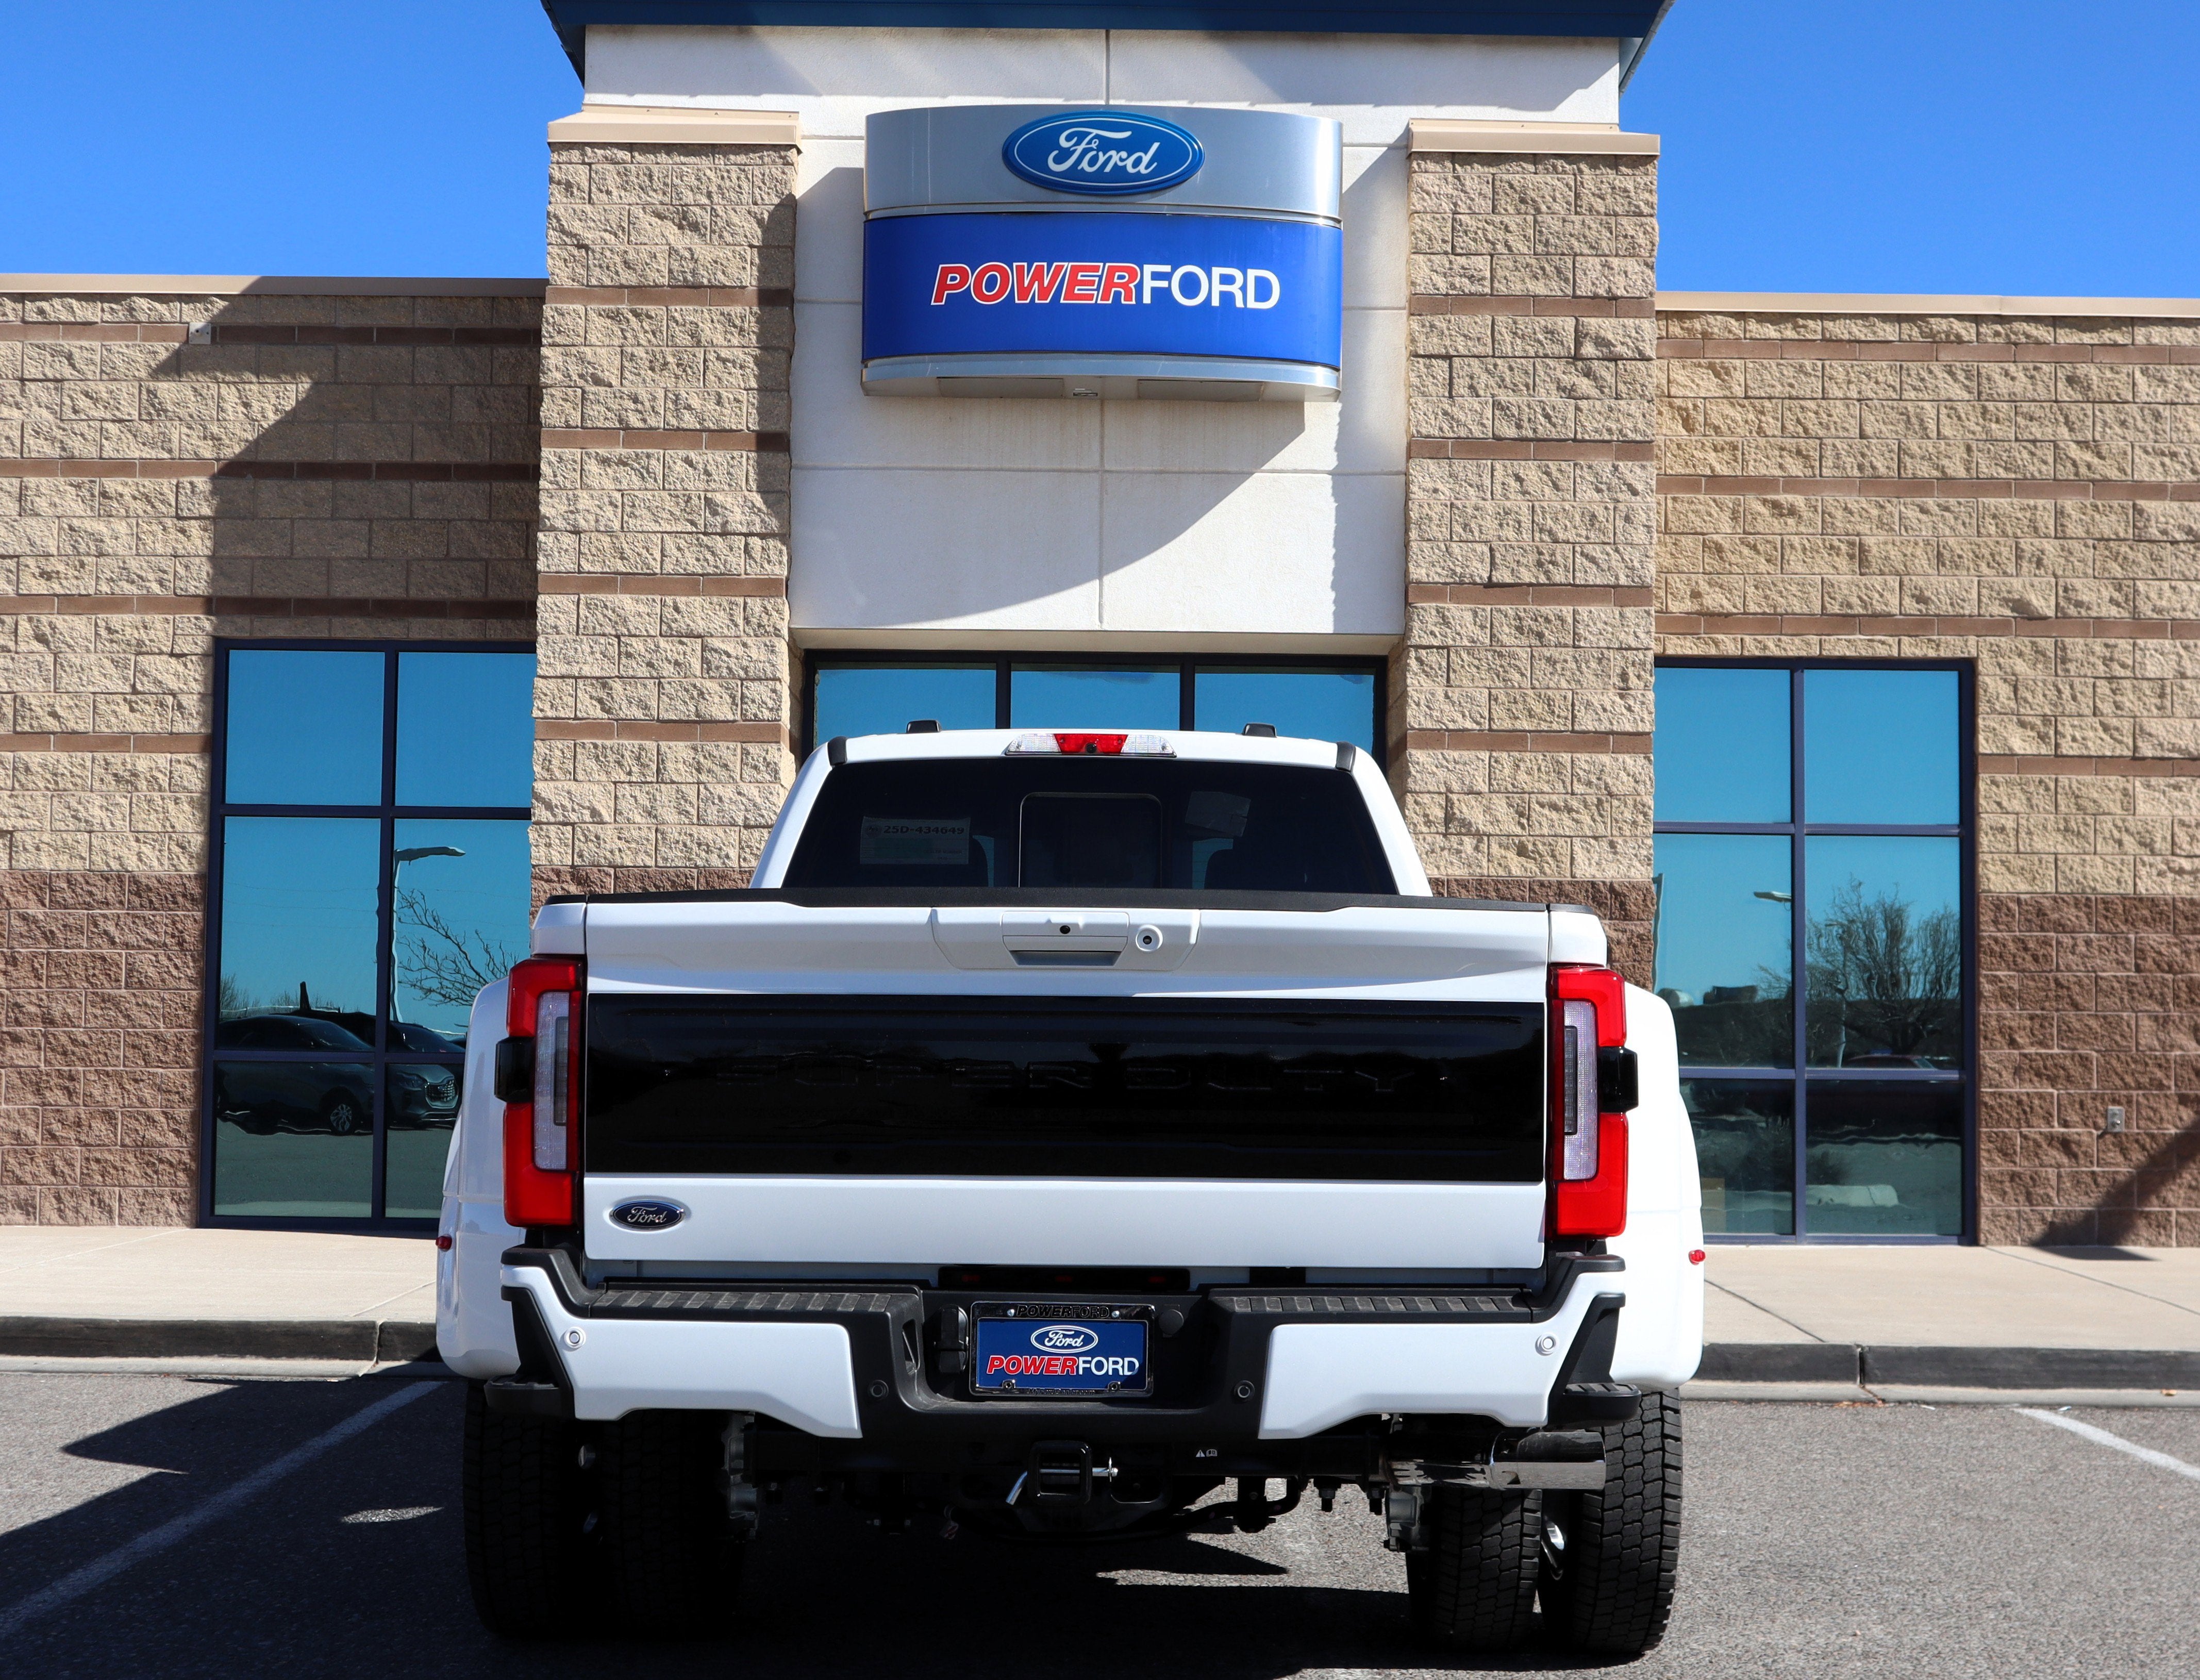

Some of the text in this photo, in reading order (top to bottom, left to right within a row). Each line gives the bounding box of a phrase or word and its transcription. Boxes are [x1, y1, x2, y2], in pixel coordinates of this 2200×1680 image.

[1047, 127, 1159, 173] Ford
[931, 262, 1280, 310] POWERFORD
[883, 825, 964, 835] 25D-434649
[627, 1206, 668, 1223] Ford
[1016, 1305, 1110, 1318] POWERFORD
[1044, 1330, 1085, 1347] Ford
[986, 1355, 1140, 1375] POWERFORD
